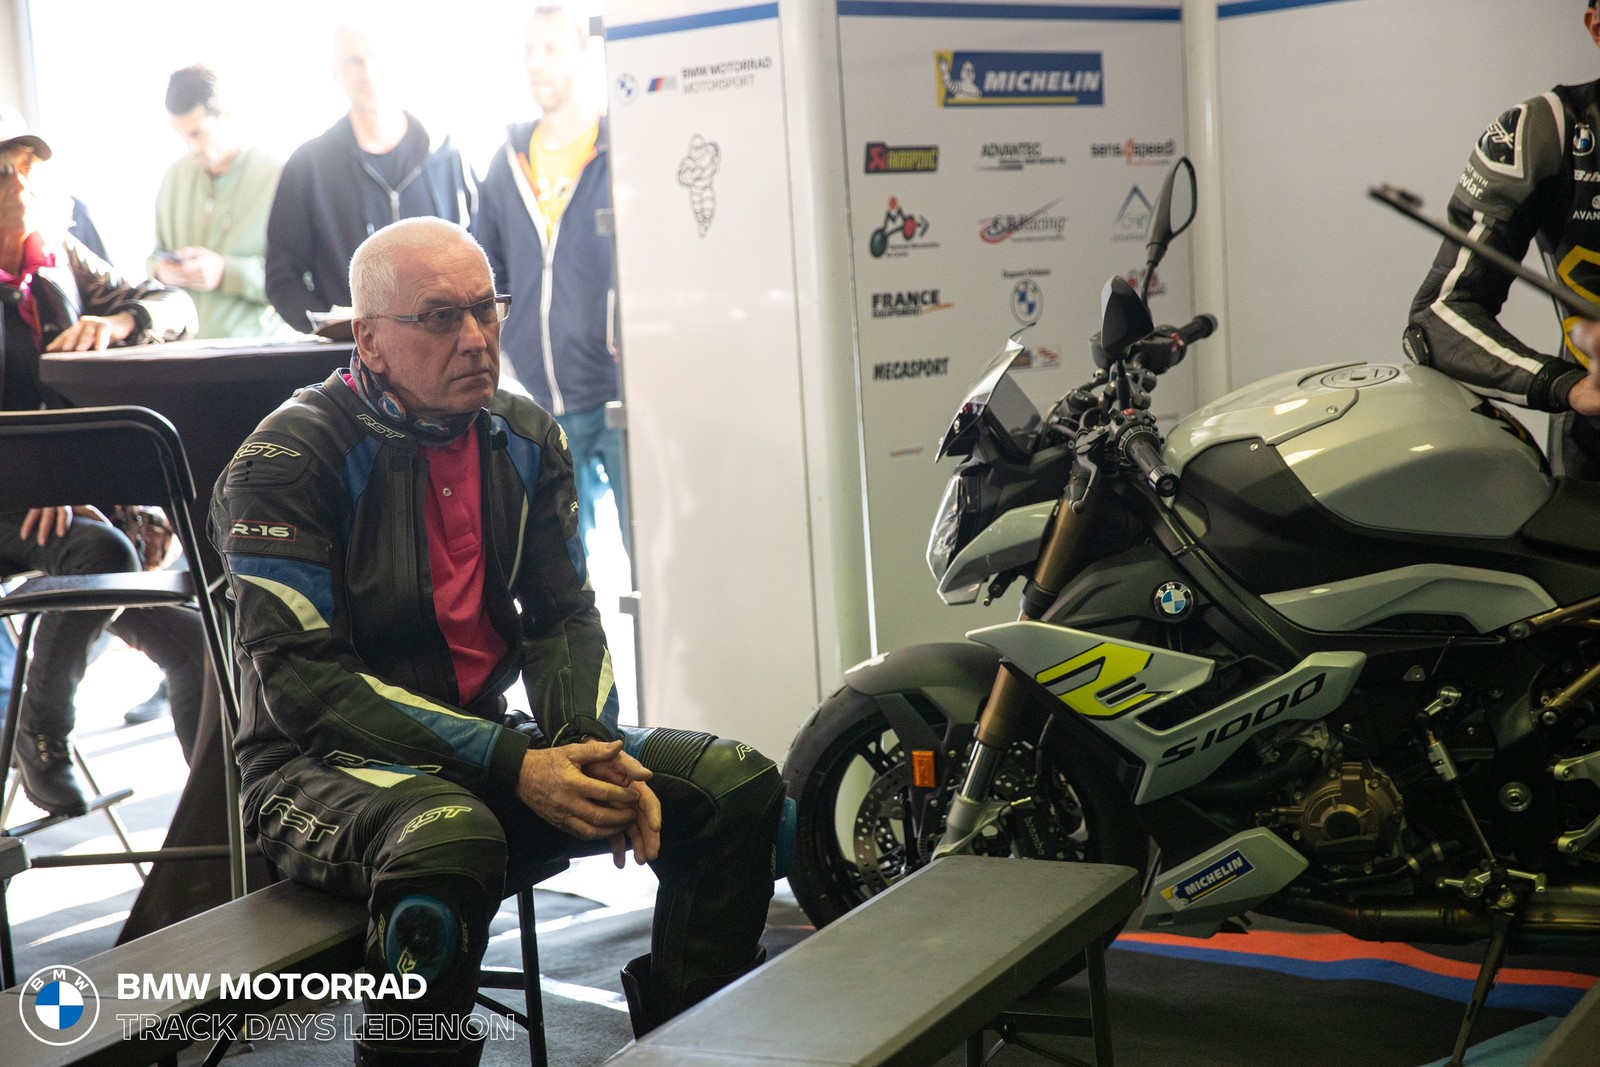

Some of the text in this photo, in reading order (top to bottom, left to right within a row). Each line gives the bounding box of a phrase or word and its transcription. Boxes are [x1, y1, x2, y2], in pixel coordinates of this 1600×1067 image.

[983, 70, 1102, 93] MICHELIN
[872, 289, 940, 308] FRANCE
[873, 357, 950, 381] MECASPORT
[356, 413, 405, 439] RST
[231, 522, 290, 538] R-16
[1157, 672, 1327, 768] S1000
[258, 795, 340, 843] RST
[396, 804, 473, 843] RST
[1183, 856, 1244, 896] MICHELIN
